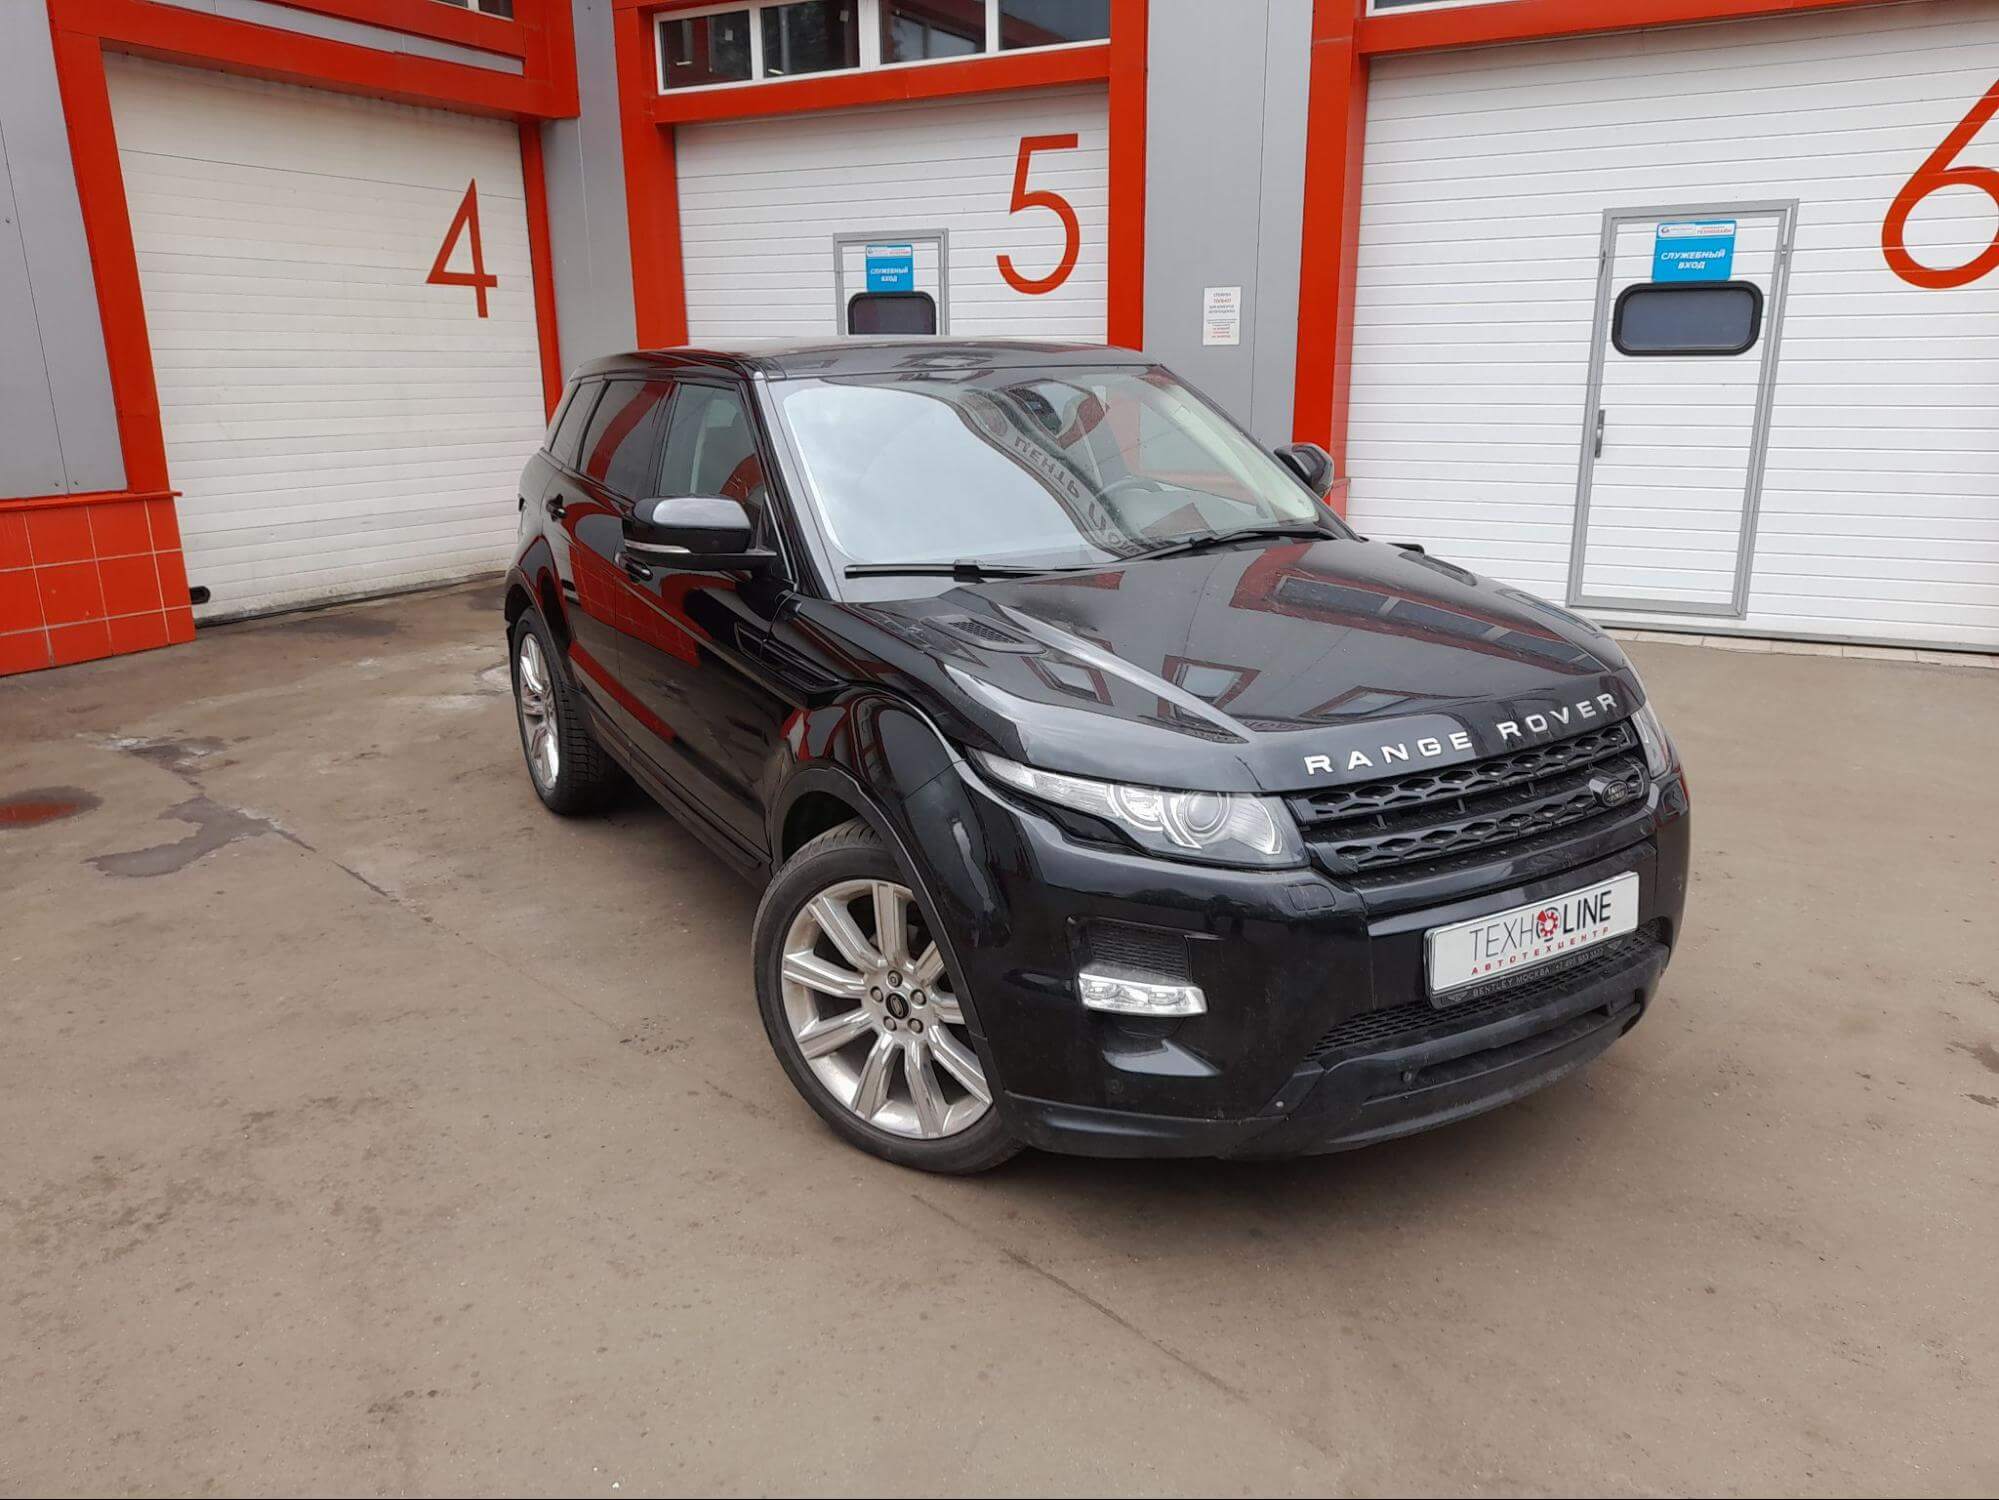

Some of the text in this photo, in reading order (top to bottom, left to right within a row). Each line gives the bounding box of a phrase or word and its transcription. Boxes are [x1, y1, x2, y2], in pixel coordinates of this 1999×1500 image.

[996, 133, 1080, 294] 5
[1882, 79, 1999, 289] 6
[426, 178, 498, 318] 4
[1661, 248, 1726, 261] СЛУЖЕБНЫЙ
[1677, 261, 1706, 270] ВХОД
[1304, 693, 1617, 775] RANGE ROVER
[1471, 926, 1610, 975] АВТОТЕХЦЕНТР
